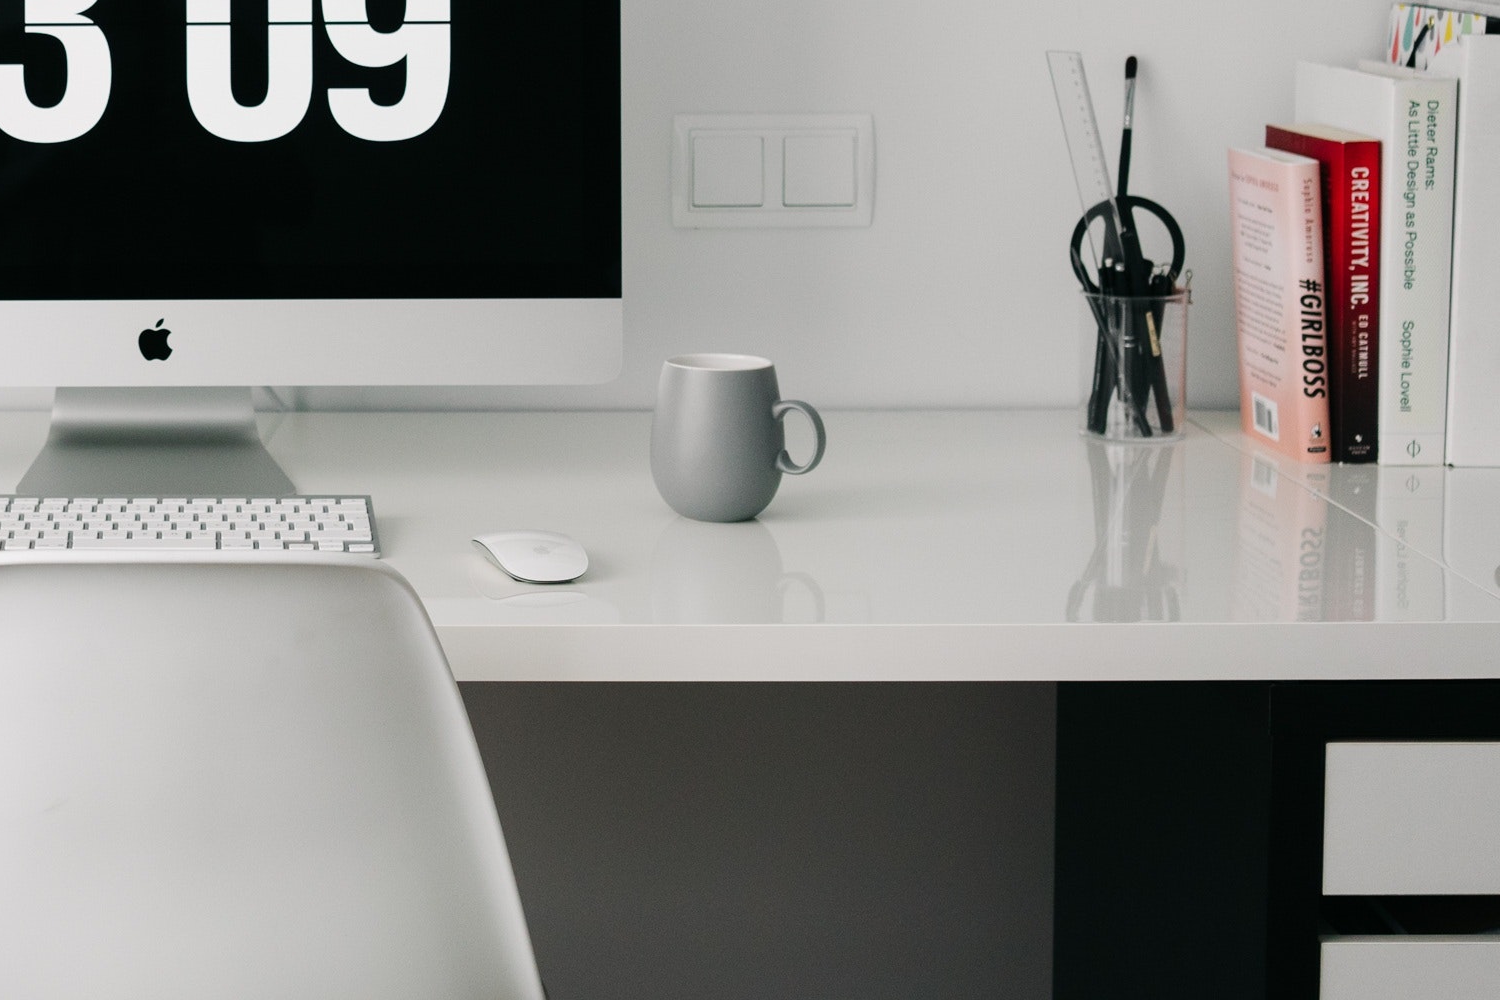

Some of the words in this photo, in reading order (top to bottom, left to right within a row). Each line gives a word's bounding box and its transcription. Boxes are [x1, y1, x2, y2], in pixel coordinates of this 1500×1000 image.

[1407, 99, 1421, 118] As
[1425, 99, 1440, 144] Dieter
[1406, 120, 1420, 158] Little
[1402, 160, 1419, 208] Design
[1424, 146, 1440, 191] Rams:
[1348, 166, 1370, 272] CREATIVITY,
[1405, 211, 1415, 229] as
[1402, 231, 1417, 291] Possible
[1350, 274, 1370, 310] INC.
[1297, 278, 1326, 399] #GIRLBOSS
[1358, 313, 1369, 329] ED
[1358, 331, 1369, 380] CATMULL
[1399, 320, 1415, 369] Sophie
[1399, 372, 1413, 412] Lovell
